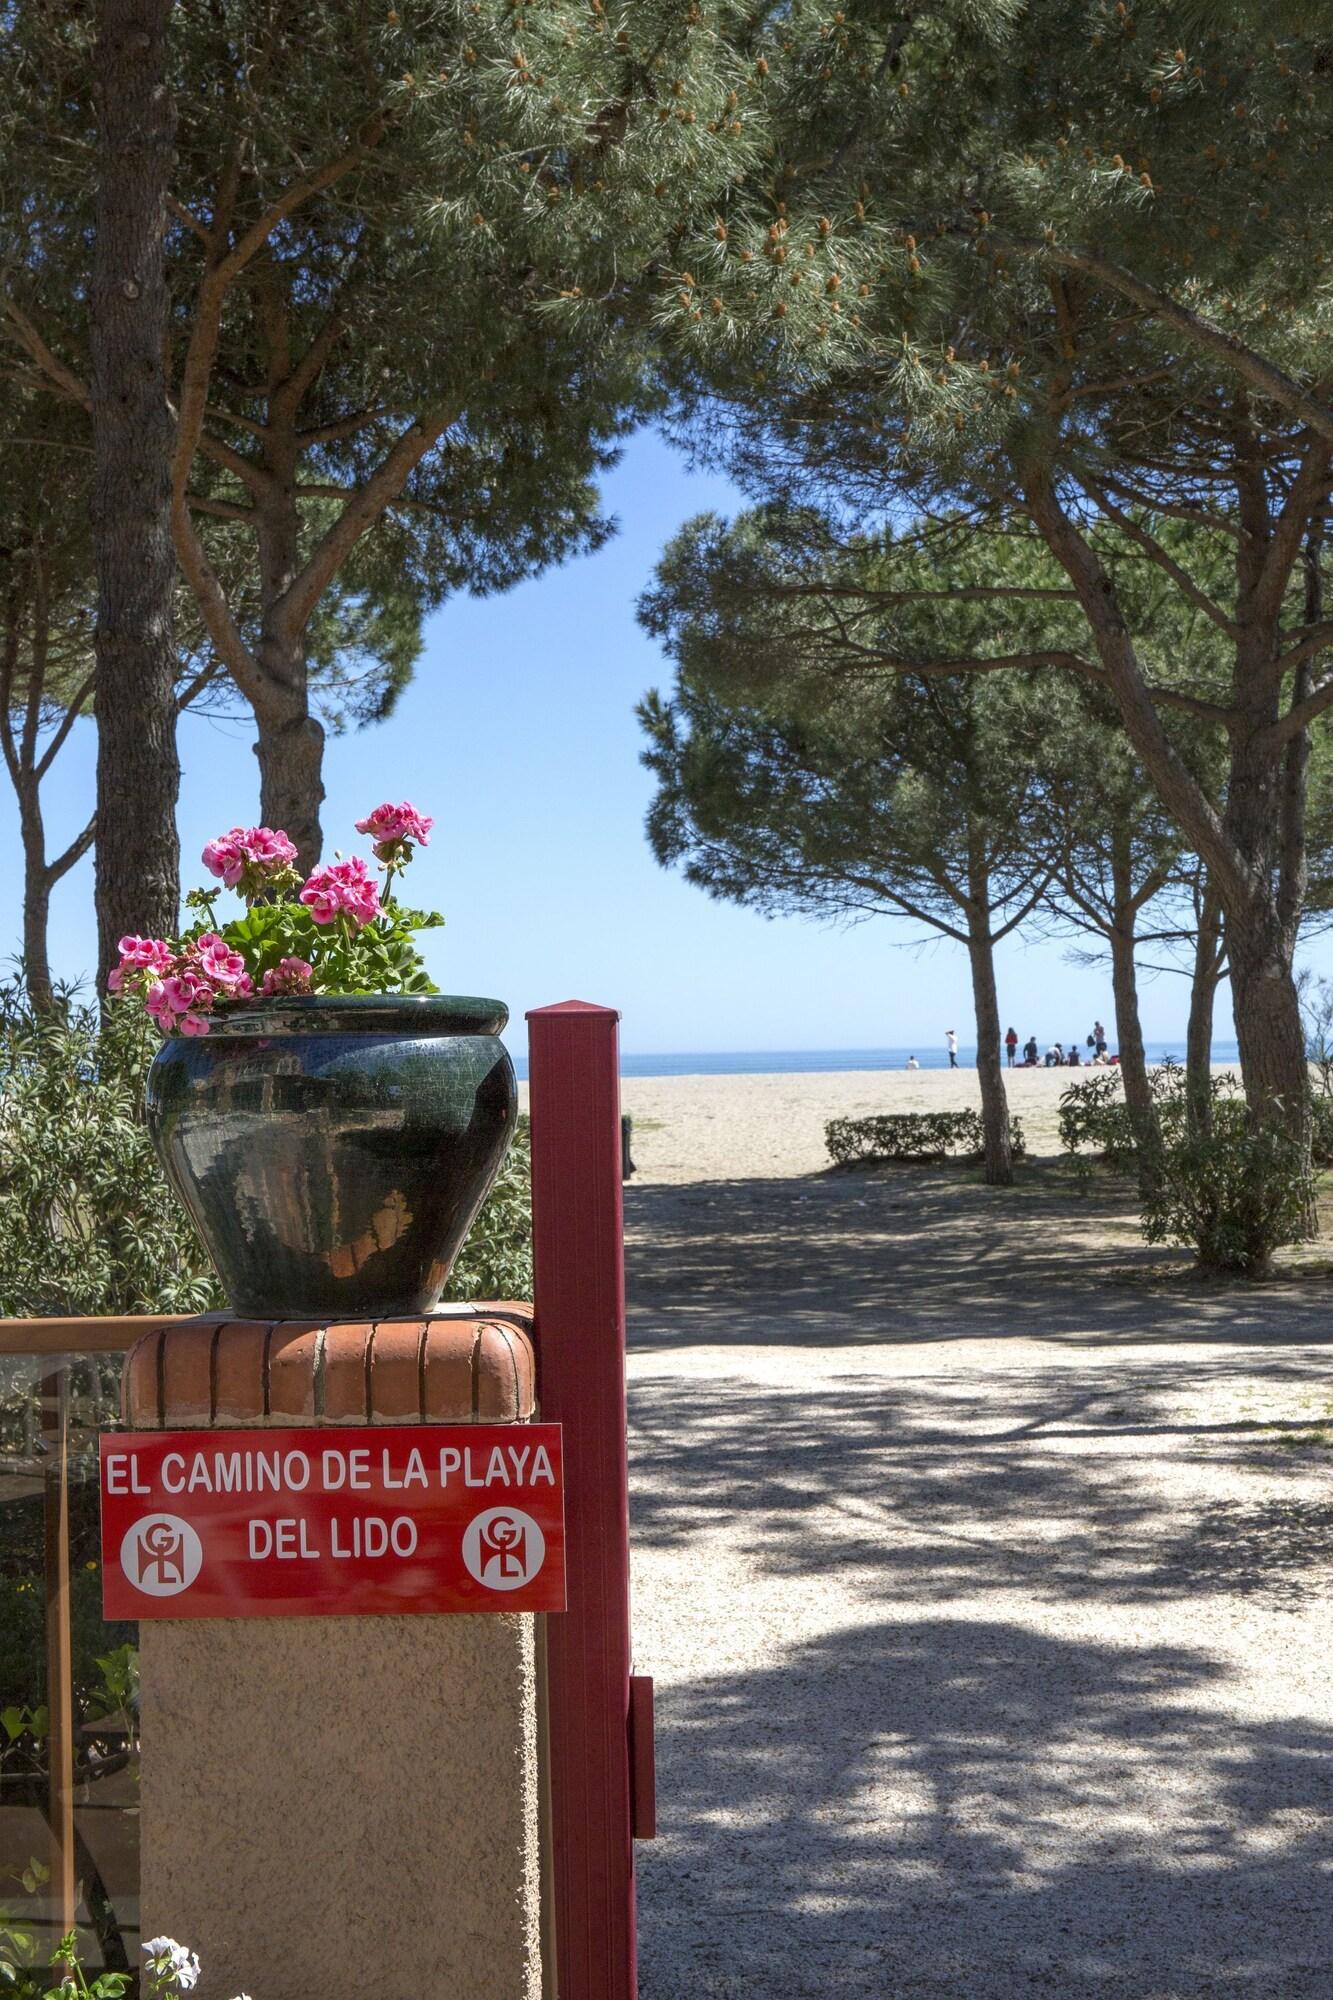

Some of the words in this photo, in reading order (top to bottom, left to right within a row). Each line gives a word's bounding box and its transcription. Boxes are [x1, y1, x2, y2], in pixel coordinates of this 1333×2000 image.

[106, 1454, 151, 1494] EL
[161, 1449, 311, 1493] CAMINO
[322, 1449, 371, 1491] DE
[382, 1447, 429, 1489] LA
[440, 1445, 556, 1488] PLAYA
[248, 1518, 320, 1560] DEL
[331, 1516, 418, 1558] LIDO
